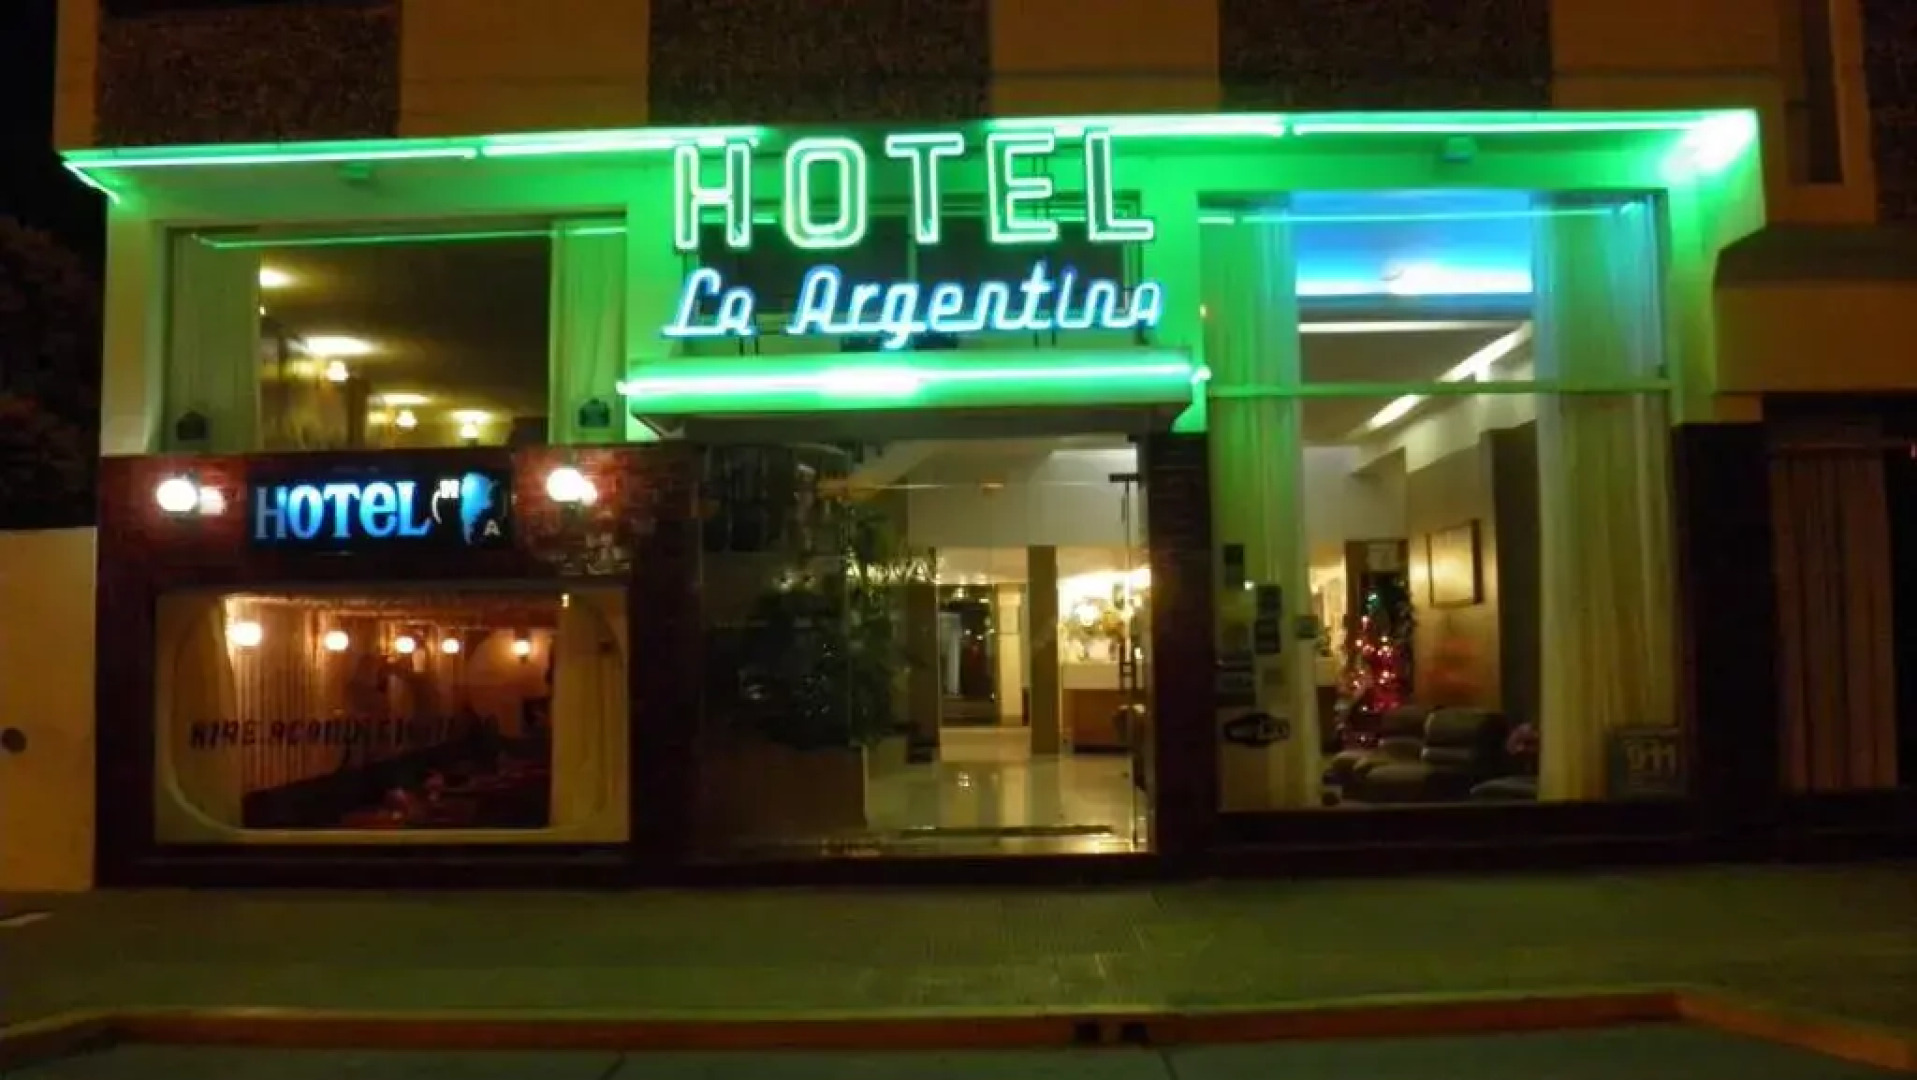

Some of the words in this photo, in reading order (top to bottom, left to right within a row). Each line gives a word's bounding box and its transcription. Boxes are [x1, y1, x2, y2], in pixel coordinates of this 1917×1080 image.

[673, 127, 1155, 249] HOTEL
[661, 267, 755, 337] La
[786, 260, 1163, 349] Argentina
